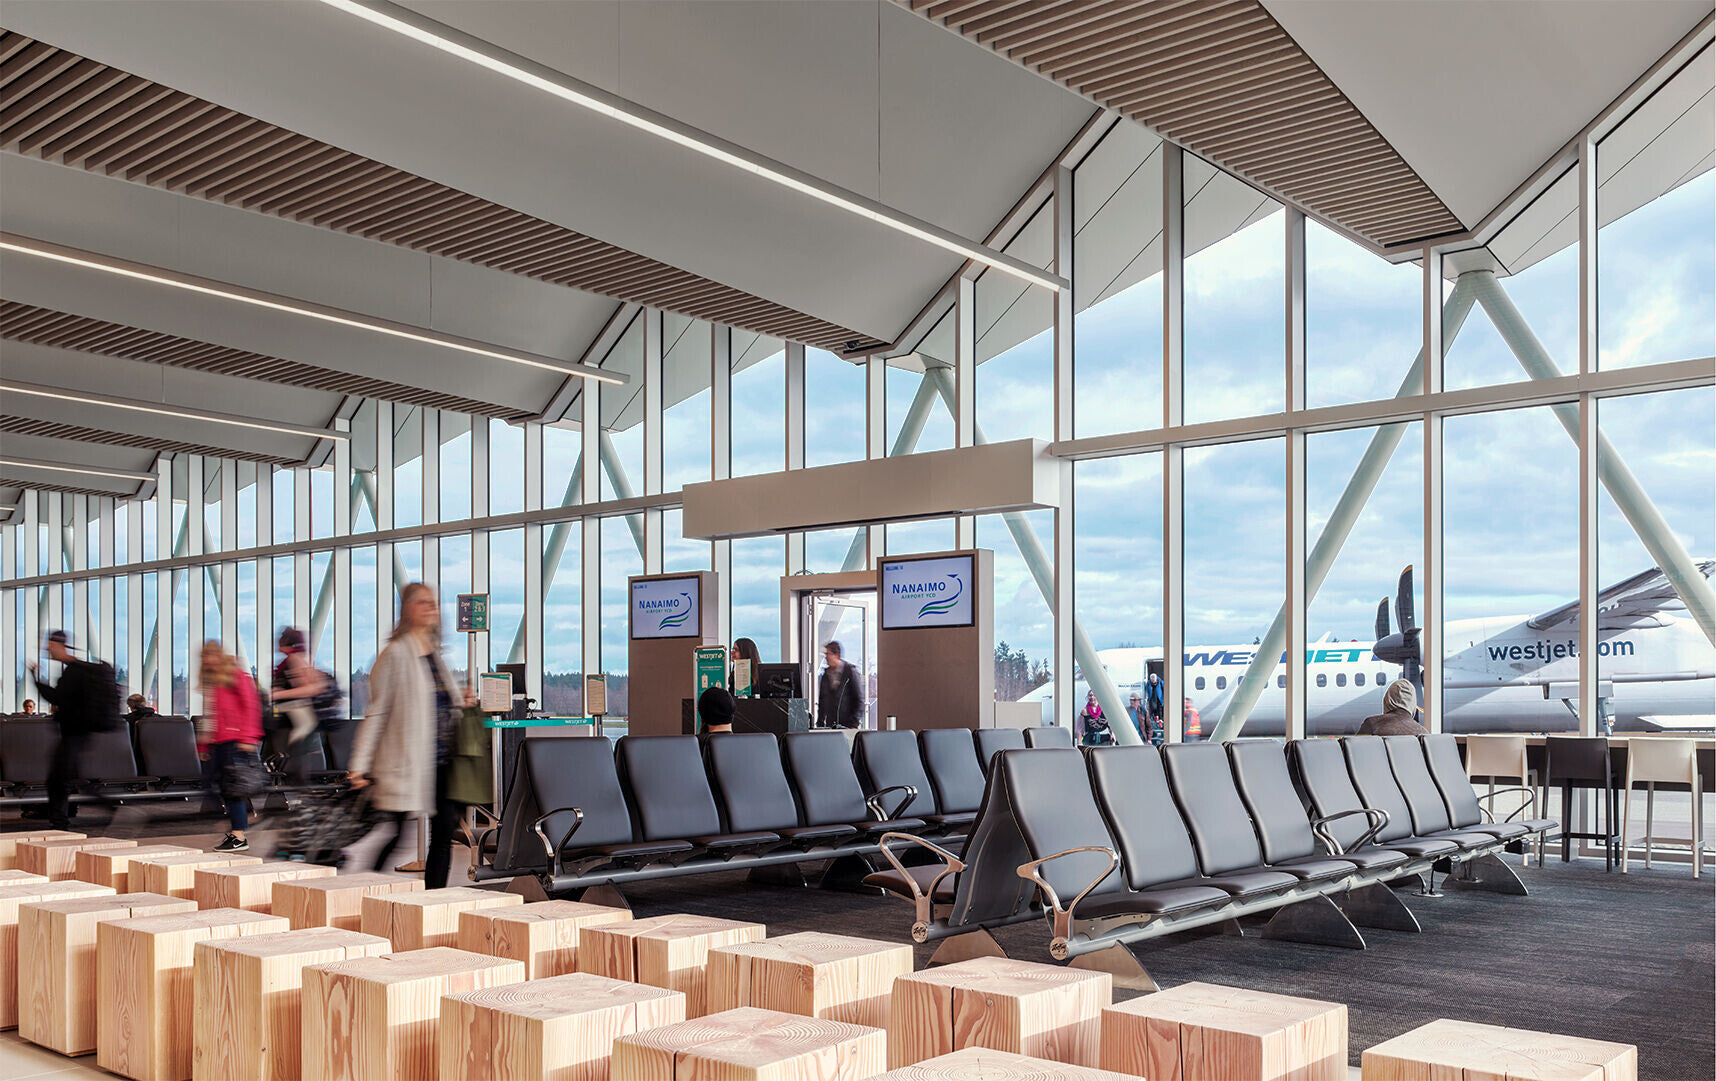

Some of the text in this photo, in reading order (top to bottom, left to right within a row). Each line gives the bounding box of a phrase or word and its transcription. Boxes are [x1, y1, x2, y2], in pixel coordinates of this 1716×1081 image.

[892, 582, 946, 594] NANAIMO
[639, 599, 680, 609] NANAIMO
[1488, 639, 1634, 663] westjet.om
